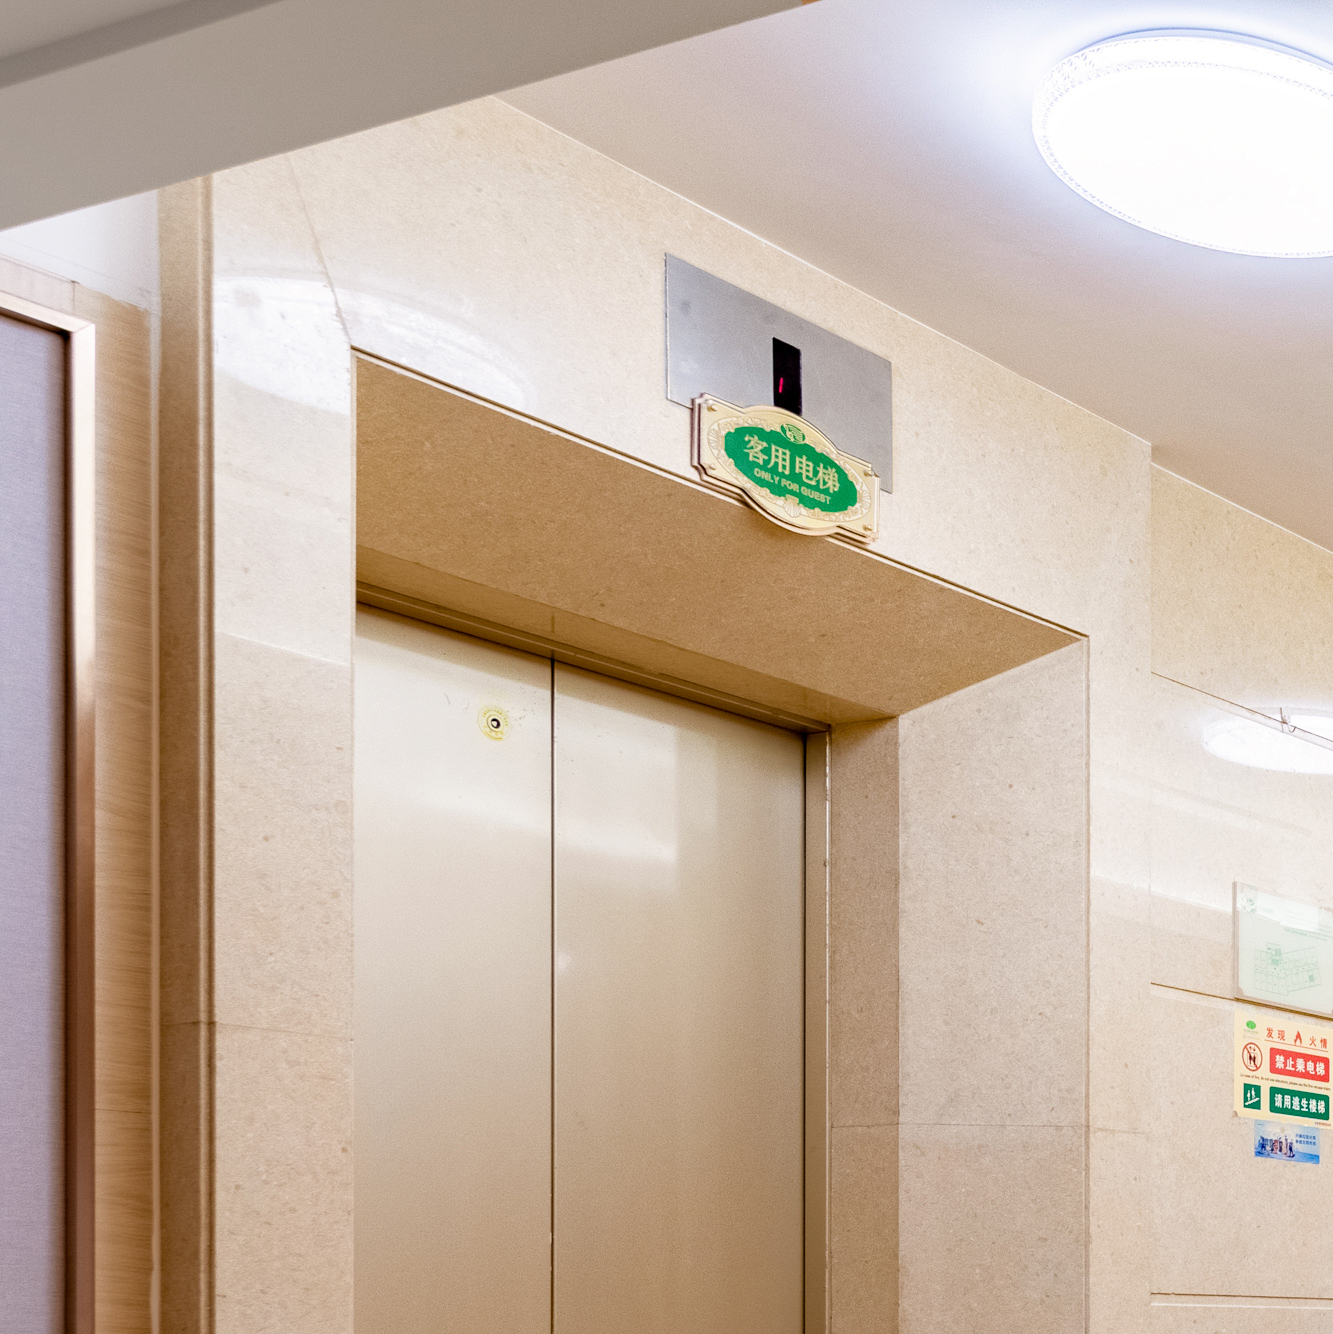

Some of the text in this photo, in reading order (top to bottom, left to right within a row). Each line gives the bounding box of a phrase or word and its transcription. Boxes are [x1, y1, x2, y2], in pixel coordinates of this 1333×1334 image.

[743, 434, 840, 494] 客用电梯
[754, 468, 831, 504] ONLY FOR GUEST
[1266, 1027, 1285, 1041] 发现
[1309, 1036, 1328, 1049] 火情
[1275, 1054, 1325, 1076] 禁止乘电梯
[1274, 1093, 1326, 1114] 请用逃生楼梯
